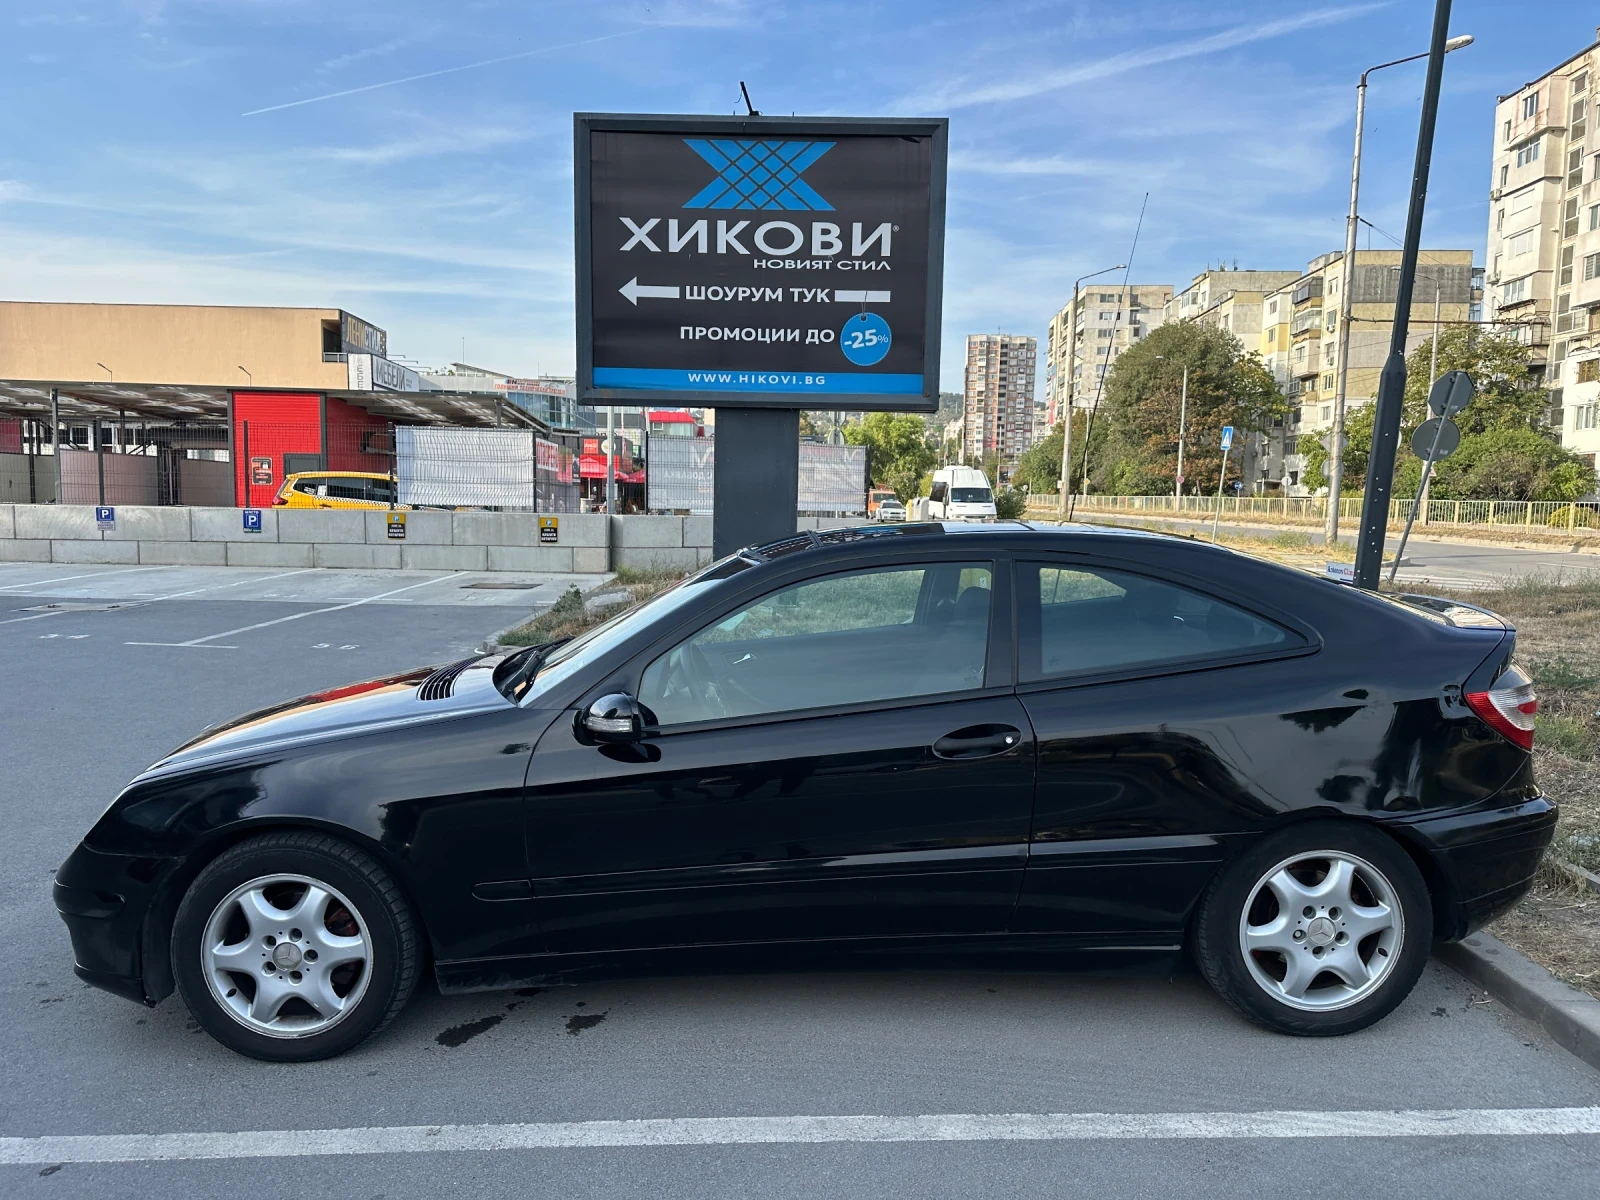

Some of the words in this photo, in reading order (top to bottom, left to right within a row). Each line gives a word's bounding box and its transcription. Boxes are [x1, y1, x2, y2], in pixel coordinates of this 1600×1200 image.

[618, 216, 892, 257] ХИКОВИ
[753, 258, 833, 270] НОВИЯТ
[836, 260, 892, 271] СТИЛ
[685, 285, 783, 302] ШОУРУМ
[789, 287, 831, 303] ТУК
[680, 326, 801, 344] ПРОМОЦИИ
[805, 328, 835, 345] ДО
[844, 328, 889, 349] -25%
[687, 372, 826, 386] WWW.HIKOVI.BG
